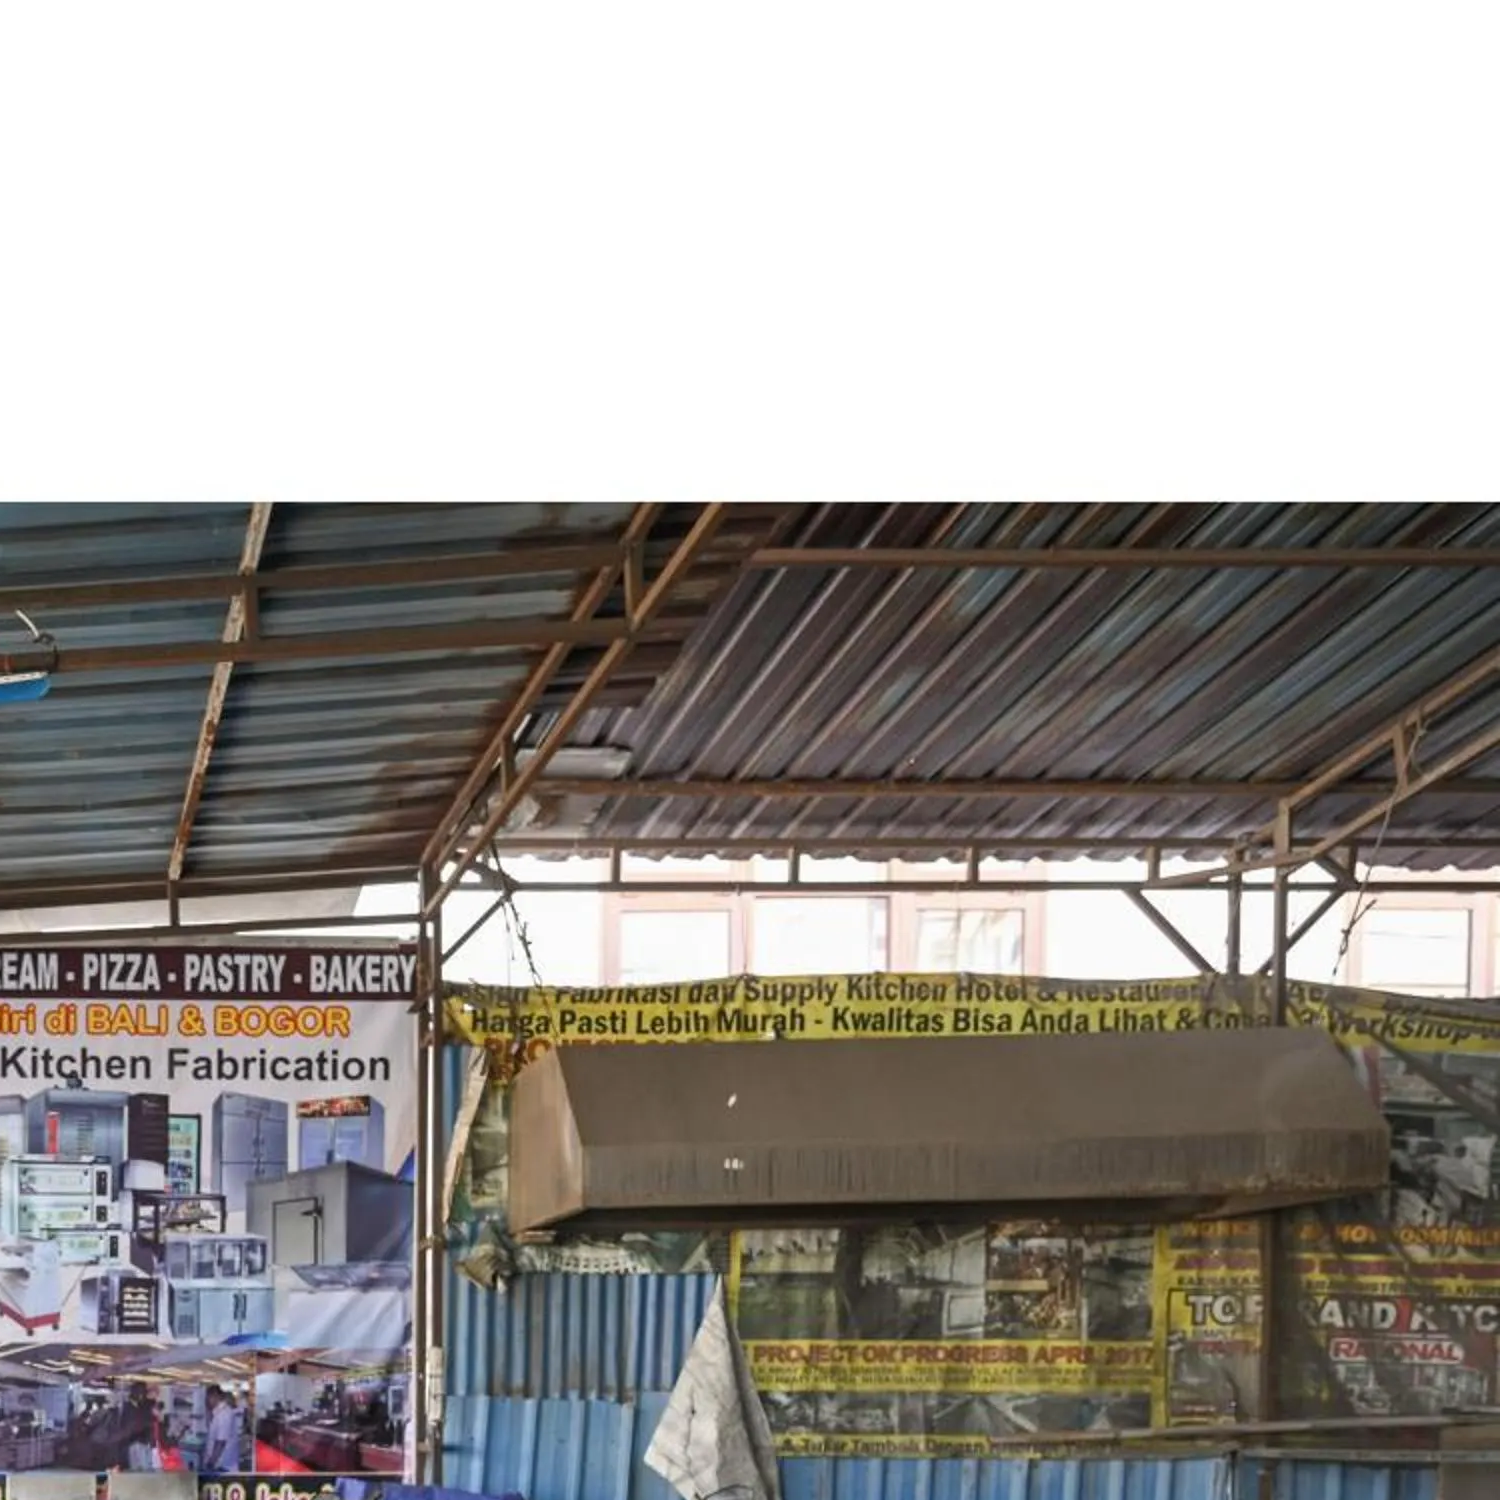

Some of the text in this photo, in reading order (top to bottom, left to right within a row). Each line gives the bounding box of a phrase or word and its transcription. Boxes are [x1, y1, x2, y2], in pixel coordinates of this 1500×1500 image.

[83, 954, 161, 990] PIZZA
[184, 955, 287, 992] PASTRY
[309, 955, 416, 992] BAKERY
[45, 1003, 77, 1035] di
[86, 1004, 168, 1035] BALI
[179, 1005, 205, 1036] &
[214, 1005, 351, 1037] BOGOR
[559, 1009, 628, 1035] Pasti
[636, 1009, 710, 1035] Lebih
[717, 1007, 805, 1034] Murah
[832, 1006, 945, 1033] Kwalitas
[953, 1006, 1013, 1033] Bisa
[1020, 1007, 1090, 1033] Anda
[1098, 1007, 1169, 1033] Lihat
[1175, 1006, 1197, 1032] &
[0, 1047, 152, 1081] Kitchen
[167, 1048, 390, 1082] Fabrication
